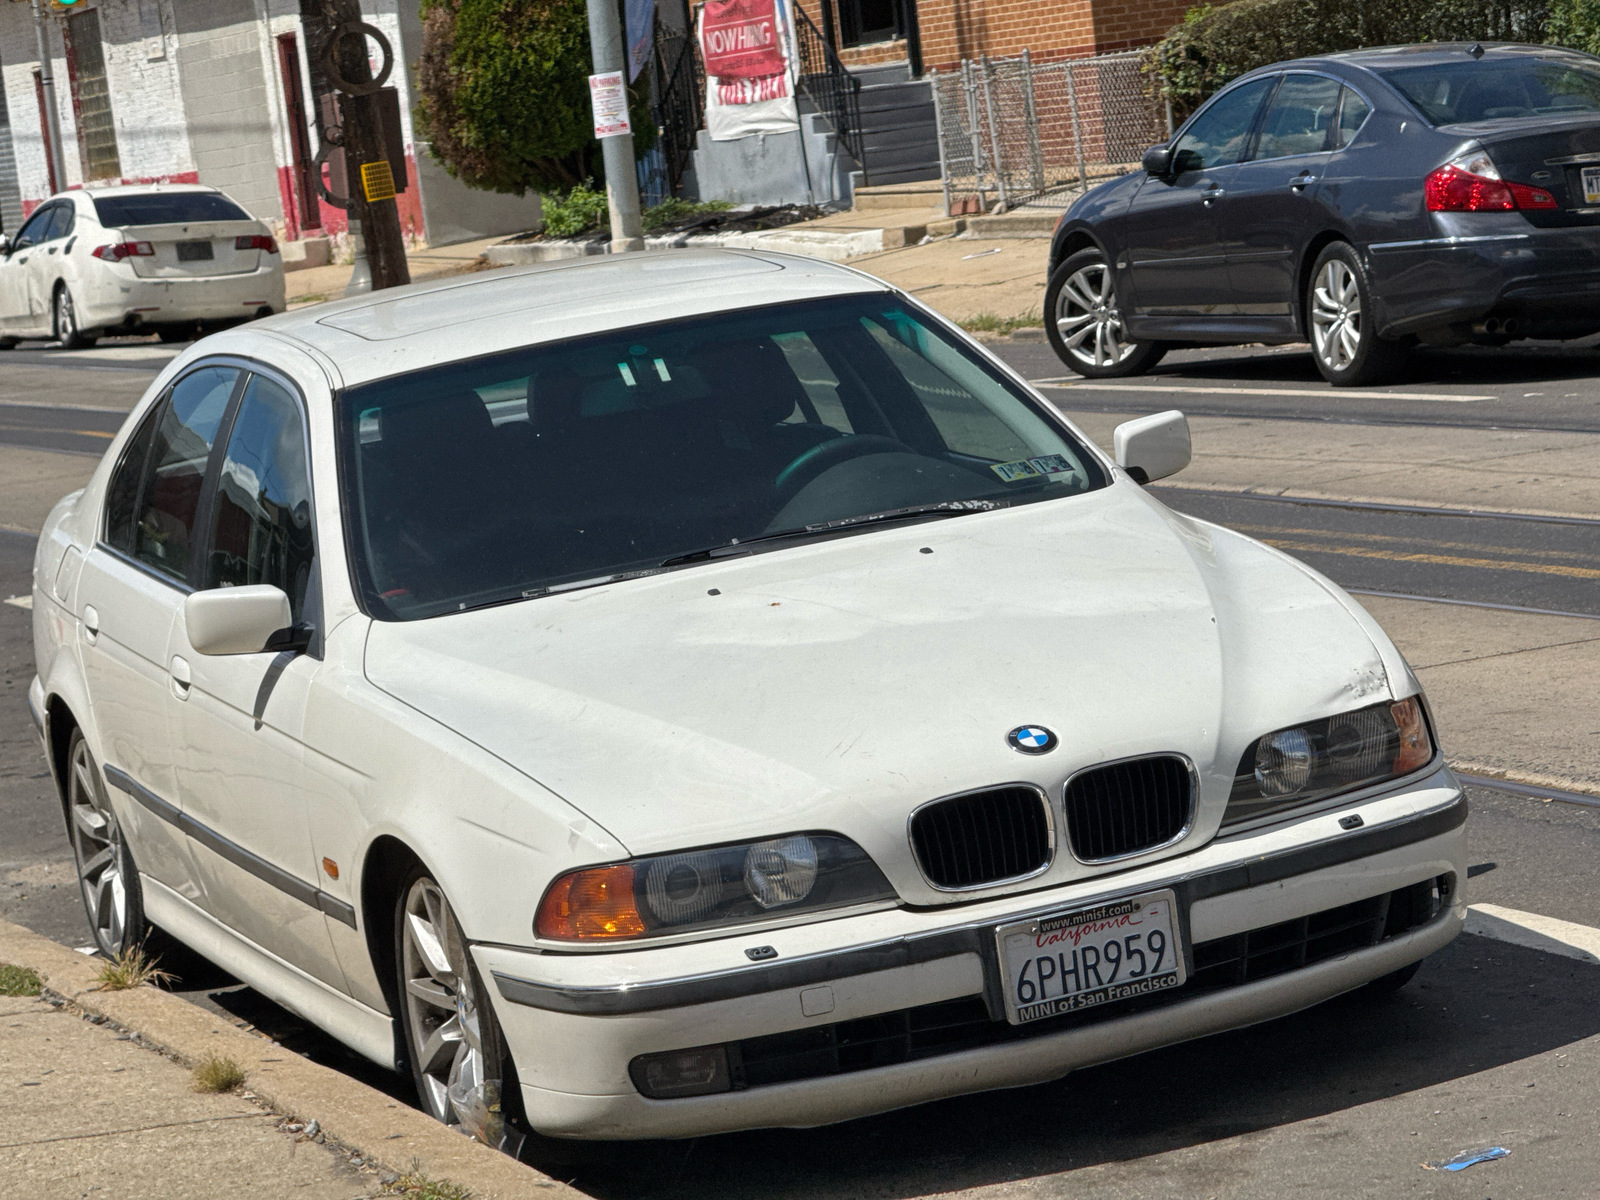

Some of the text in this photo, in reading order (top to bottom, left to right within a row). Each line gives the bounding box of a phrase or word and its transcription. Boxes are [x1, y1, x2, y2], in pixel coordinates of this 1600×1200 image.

[706, 28, 737, 54] NOW
[1036, 914, 1143, 948] California
[1041, 903, 1132, 932] www.minisf.com
[1017, 929, 1166, 1003] 6PHR959
[1019, 975, 1177, 1022] MINI of San Francisco
